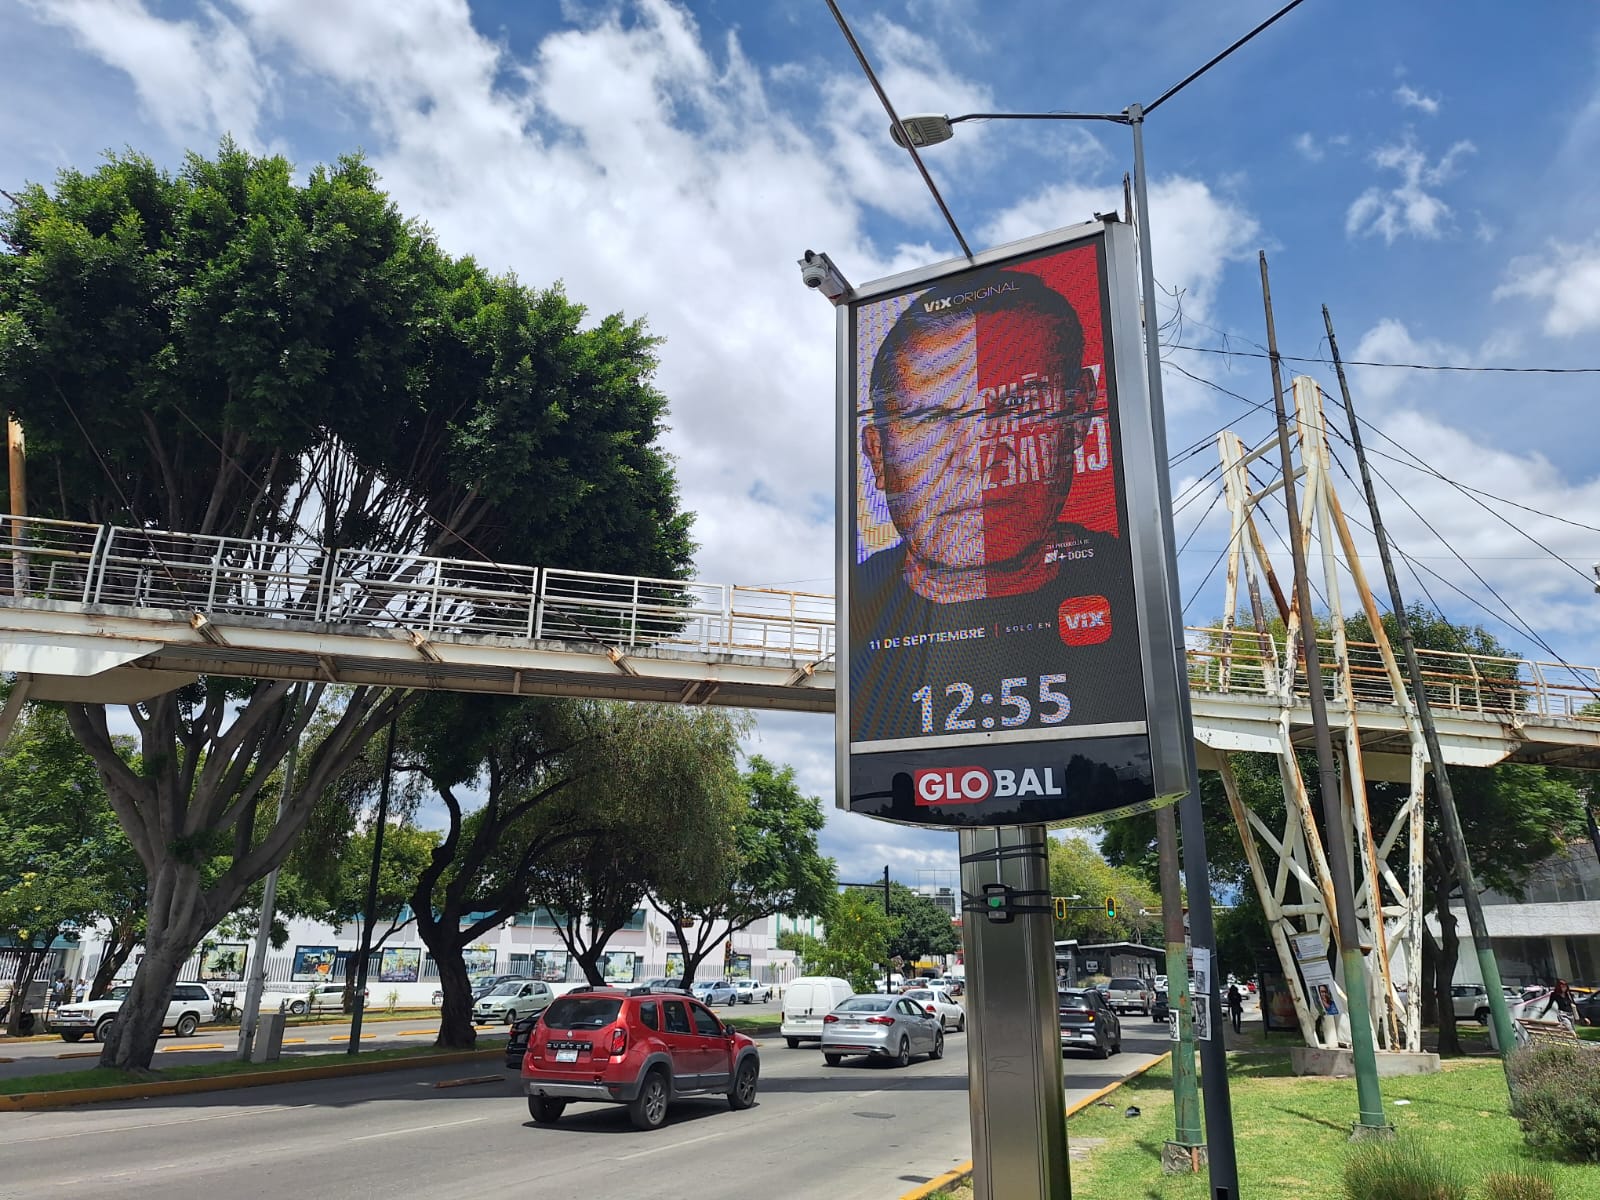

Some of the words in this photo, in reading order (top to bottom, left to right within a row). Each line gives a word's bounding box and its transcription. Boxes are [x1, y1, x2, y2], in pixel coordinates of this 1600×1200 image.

[953, 280, 1020, 305] ORIGINAL
[869, 640, 881, 650] 11
[883, 637, 900, 649] DE
[903, 627, 985, 647] SEPTIEMBRE
[1006, 623, 1033, 633] SOLO
[1038, 622, 1051, 630] EN
[911, 673, 1071, 733] 12:55
[918, 767, 1062, 801] GLOBAL
